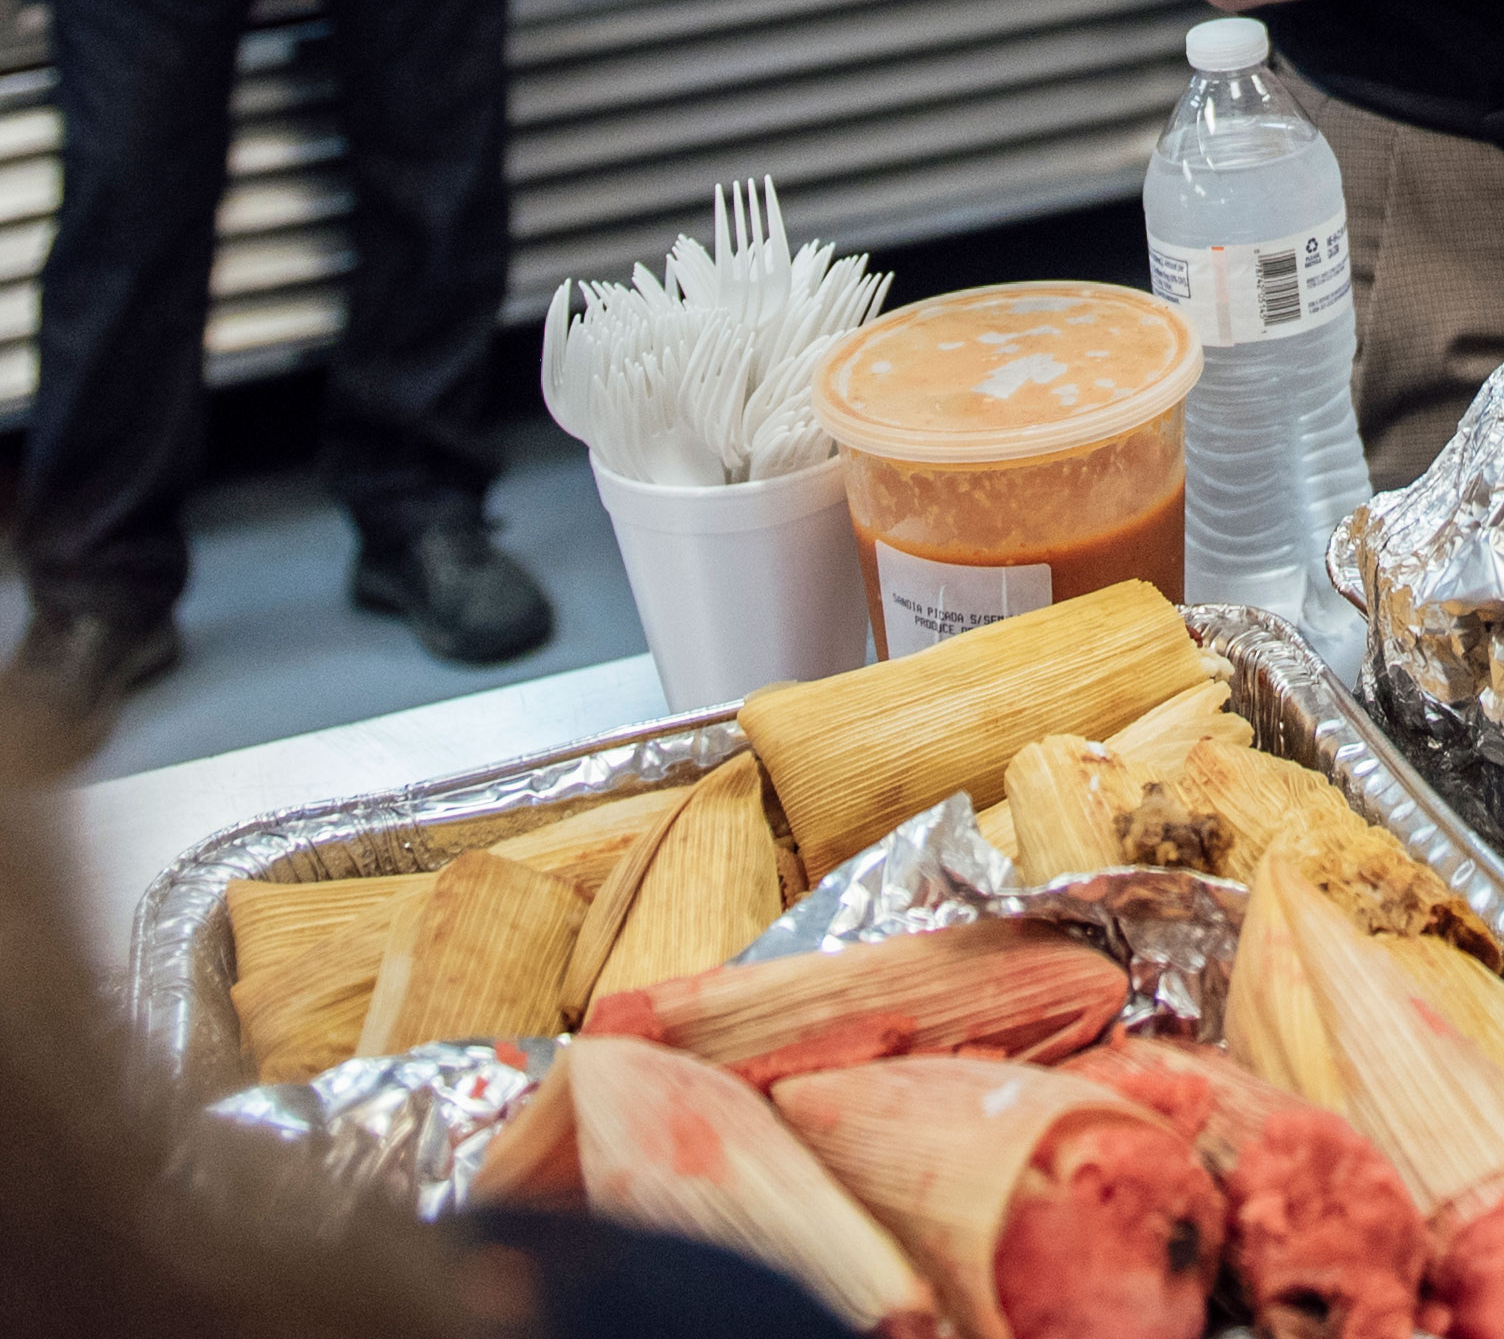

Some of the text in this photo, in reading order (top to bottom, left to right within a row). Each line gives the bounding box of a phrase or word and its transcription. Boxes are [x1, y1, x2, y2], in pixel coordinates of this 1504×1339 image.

[893, 593, 922, 614] SANDIA
[927, 606, 964, 624] PICADA
[914, 615, 956, 636] PRODUCE
